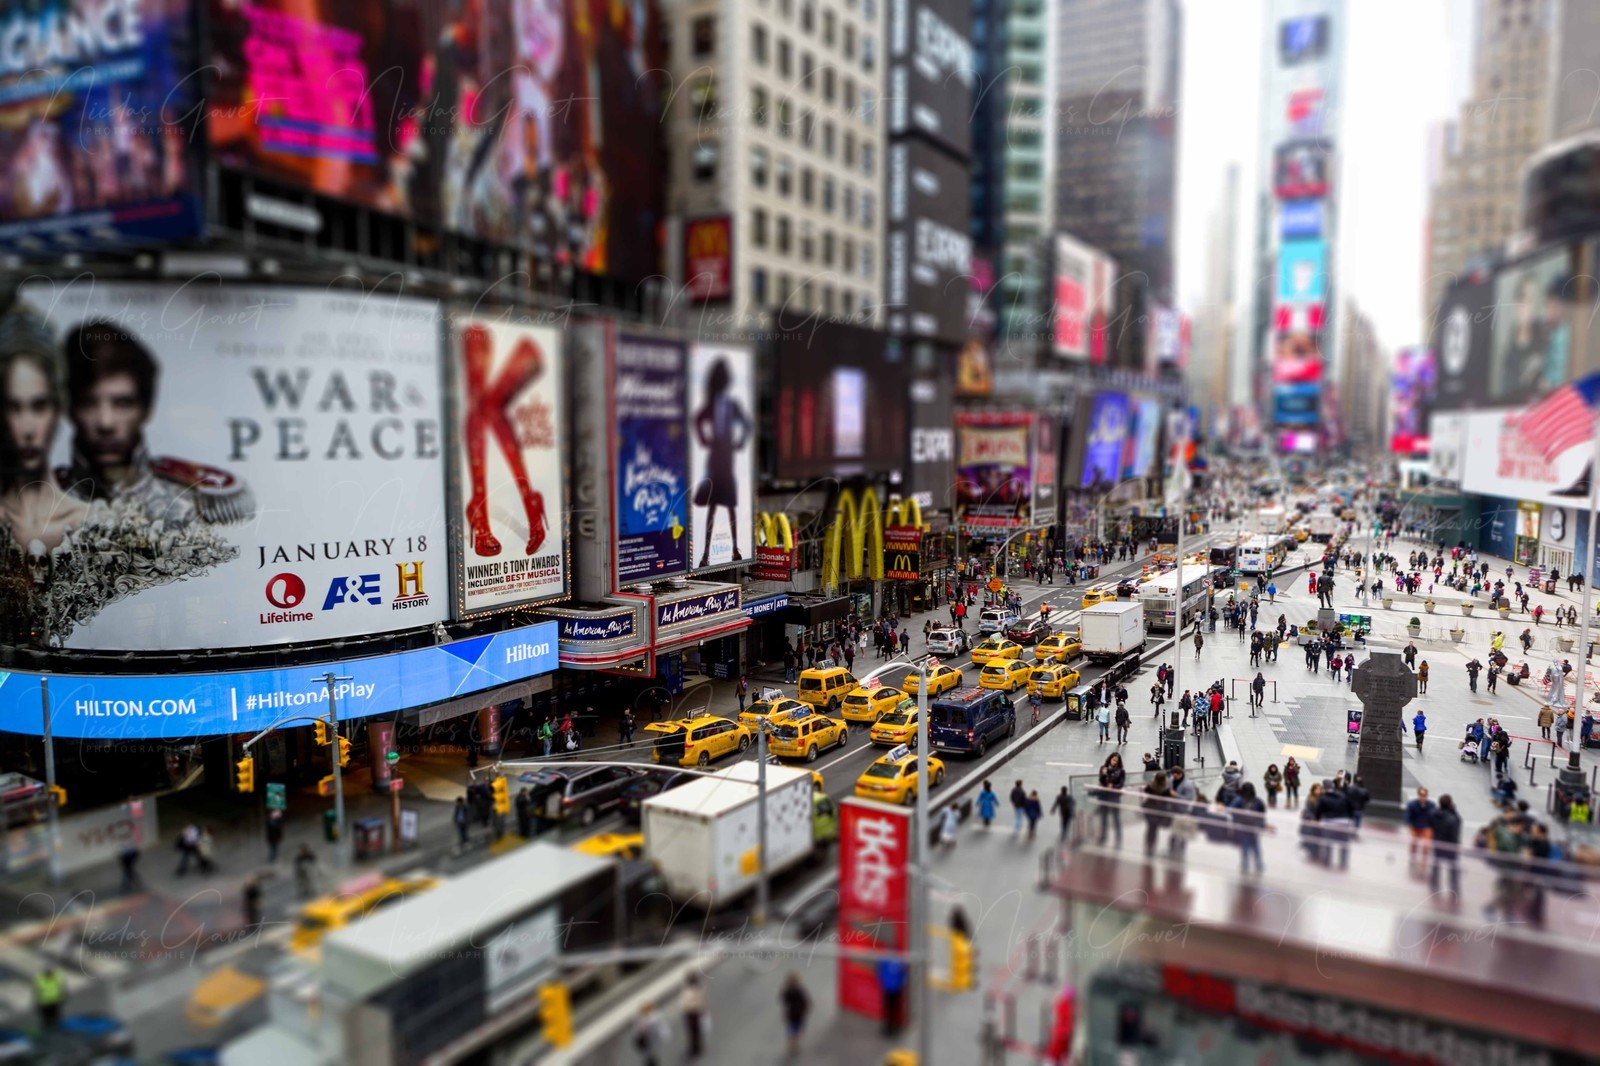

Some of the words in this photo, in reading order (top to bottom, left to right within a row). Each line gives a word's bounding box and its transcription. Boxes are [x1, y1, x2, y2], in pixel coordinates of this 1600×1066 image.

[252, 368, 401, 412] WAR
[227, 417, 440, 461] PEACE
[258, 538, 395, 569] JANUARY
[405, 534, 428, 554] 18
[757, 552, 791, 562] cDonald's
[467, 562, 501, 579] WINNER!
[503, 561, 508, 574] 6
[510, 558, 530, 573] TONY
[531, 554, 560, 570] AWARDS
[468, 576, 504, 588] INCLUDING
[506, 573, 526, 582] BEST
[527, 568, 560, 579] MUSICAL
[322, 573, 382, 612] A&E
[392, 597, 430, 611] HISTORY
[260, 611, 314, 625] Lifetime
[672, 603, 704, 623] American
[705, 596, 722, 612] Paris
[754, 602, 774, 614] MONEY
[776, 598, 788, 608] ATM
[573, 621, 607, 638] American
[506, 641, 550, 664] Hilton
[246, 682, 376, 711] #HiltonAtPlay
[75, 700, 197, 718] HILTON.COM
[855, 817, 899, 908] tkts
